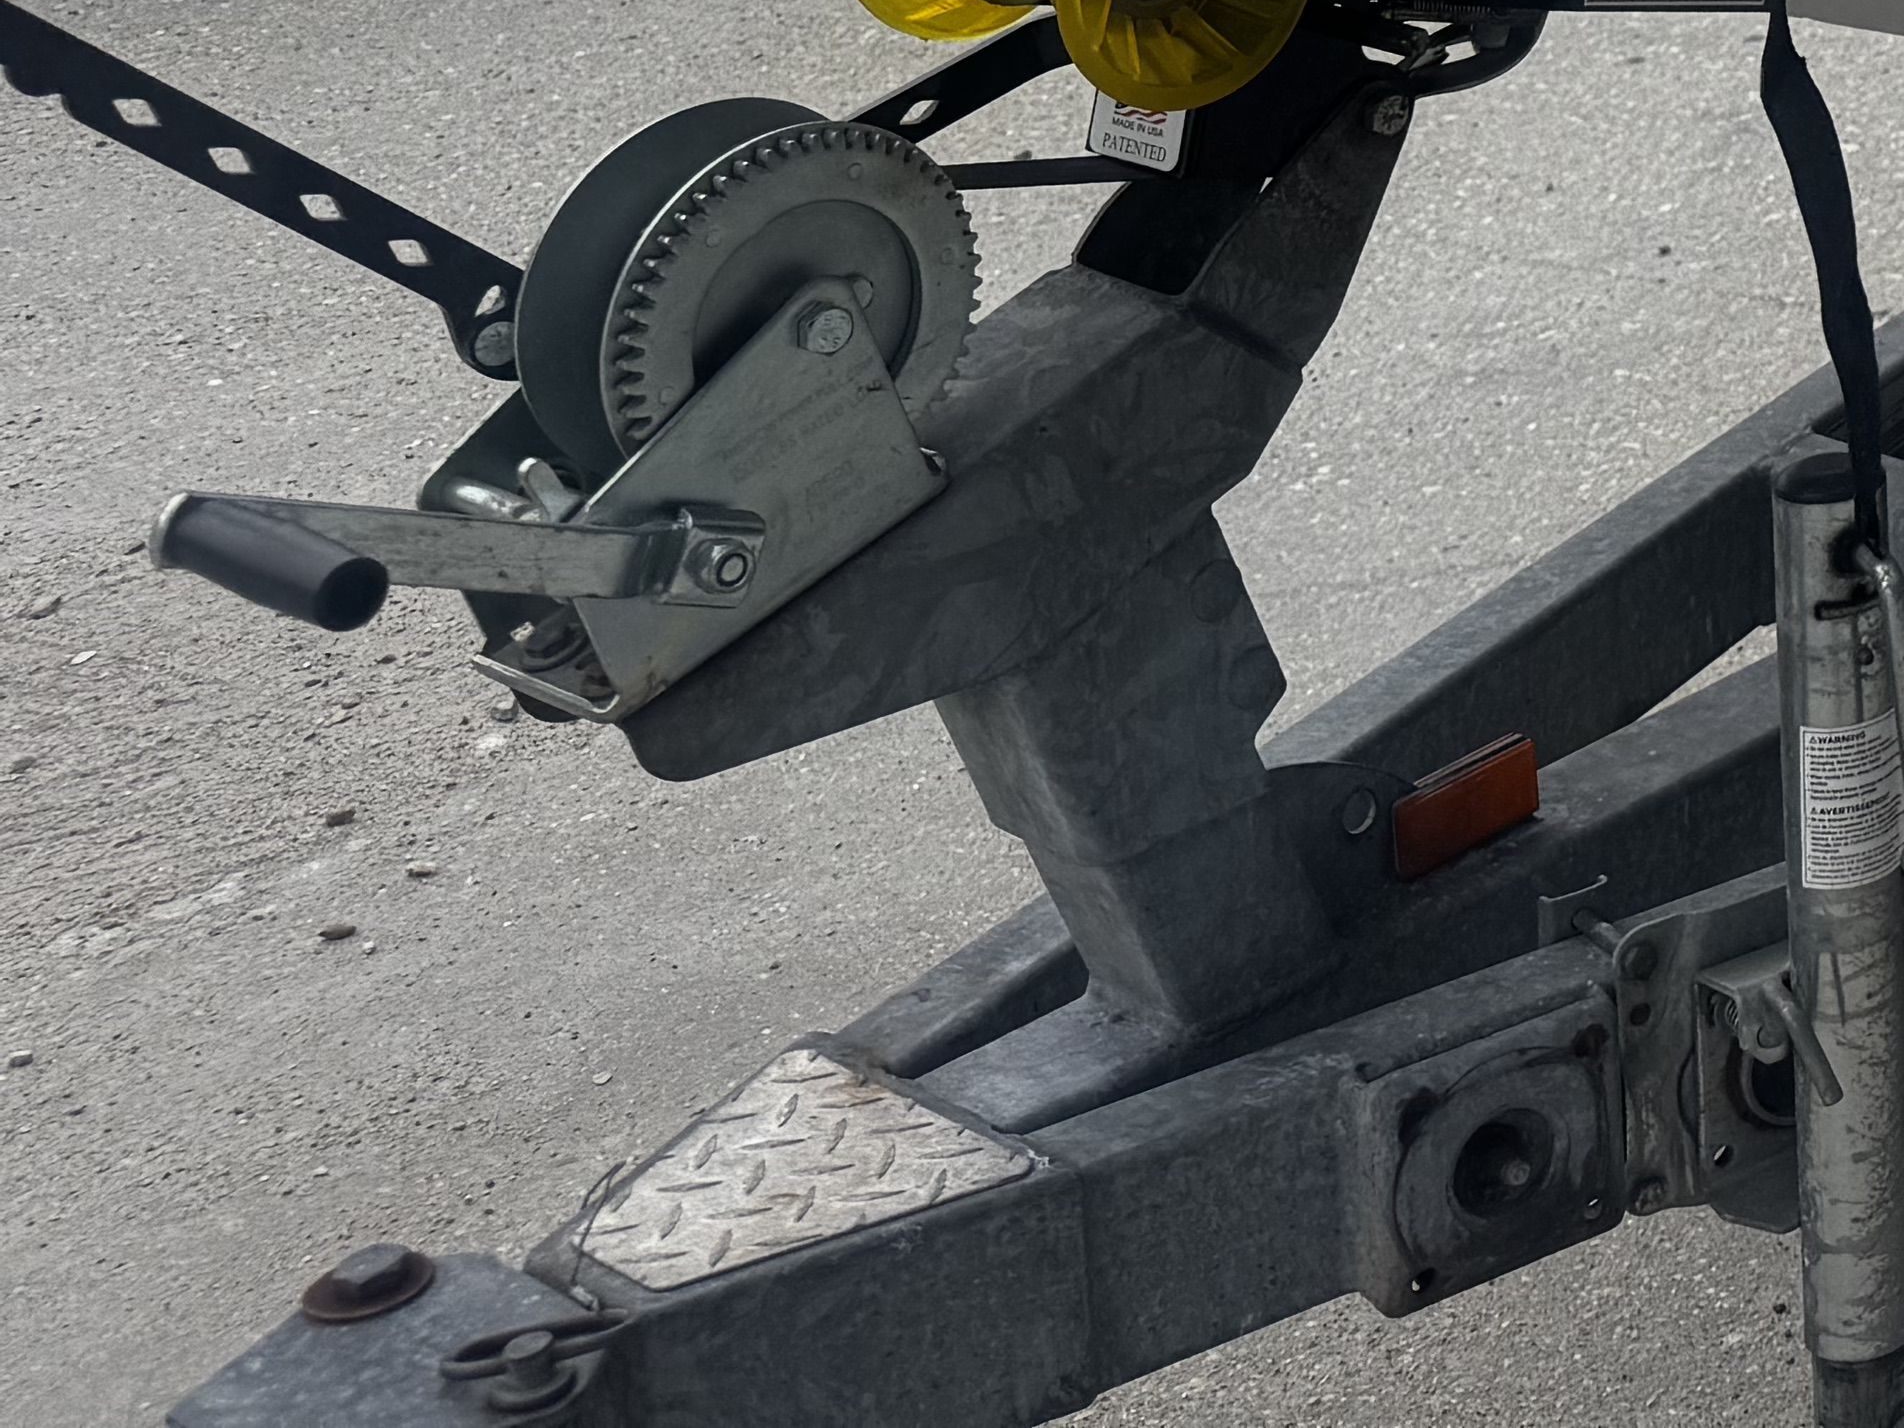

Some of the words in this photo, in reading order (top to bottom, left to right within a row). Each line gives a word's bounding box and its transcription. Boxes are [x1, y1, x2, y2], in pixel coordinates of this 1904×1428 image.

[1112, 116, 1135, 131] MADE
[1136, 123, 1146, 134] IN
[1147, 125, 1164, 138] USA
[1102, 132, 1167, 162] PATENTED
[1817, 730, 1866, 745] WARNING
